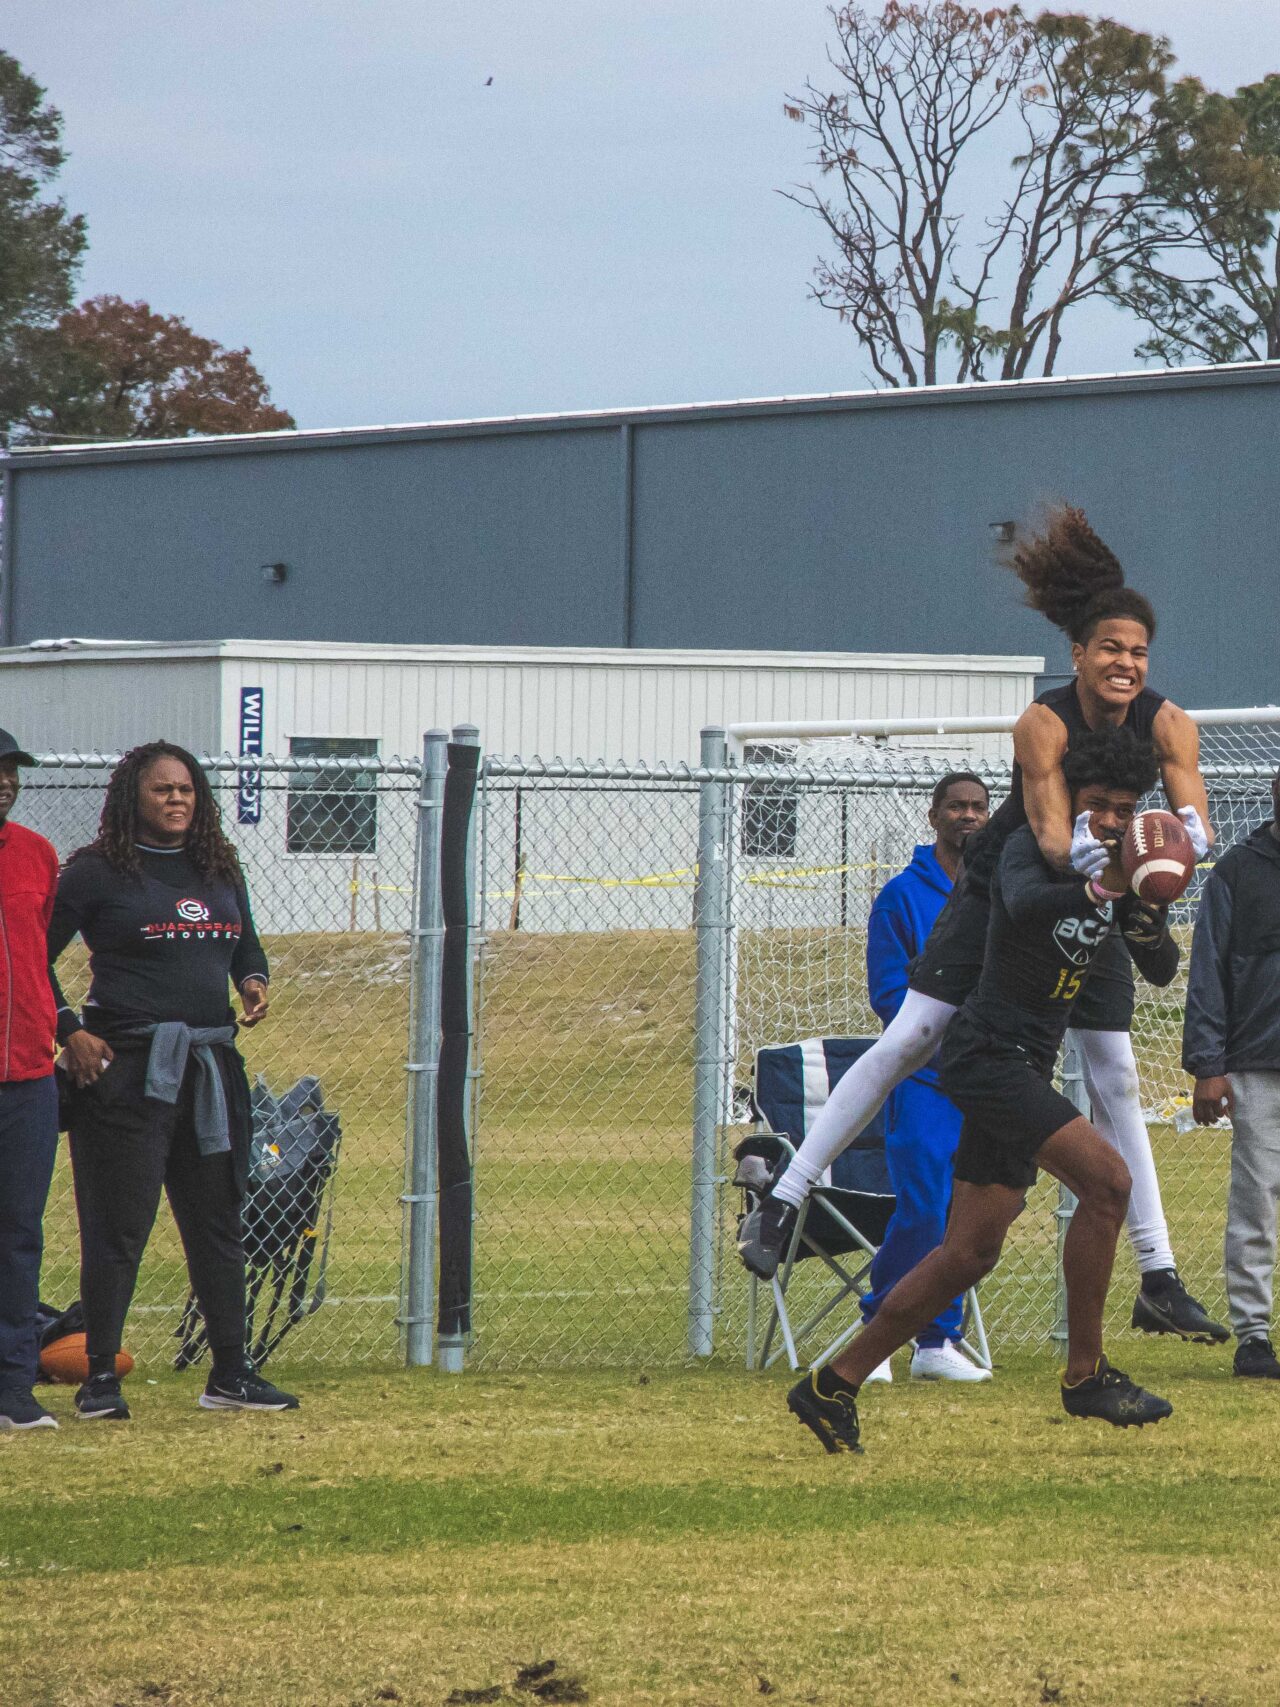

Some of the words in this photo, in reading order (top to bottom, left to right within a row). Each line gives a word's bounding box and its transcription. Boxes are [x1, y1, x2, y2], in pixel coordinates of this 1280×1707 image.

[243, 693, 260, 817] WILLCOT
[166, 931, 232, 939] HOUSE
[1049, 968, 1087, 999] 15
